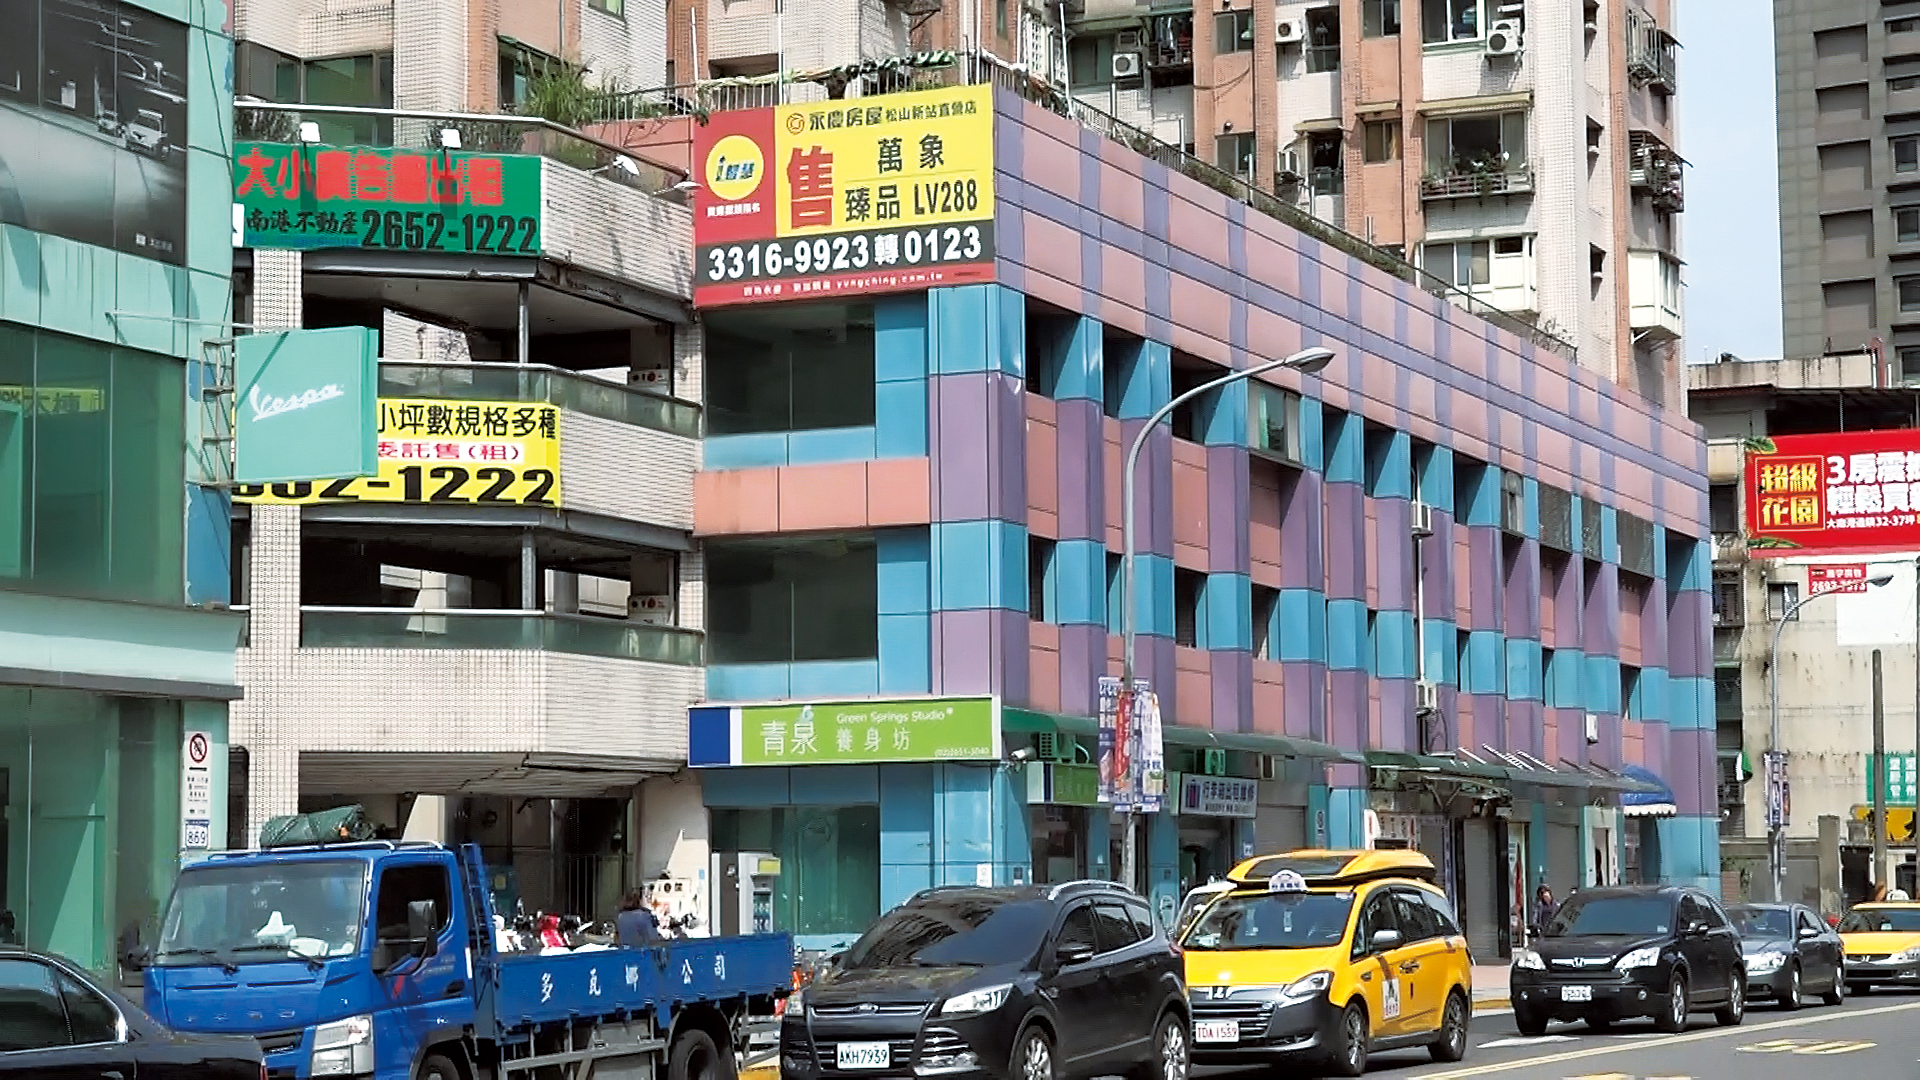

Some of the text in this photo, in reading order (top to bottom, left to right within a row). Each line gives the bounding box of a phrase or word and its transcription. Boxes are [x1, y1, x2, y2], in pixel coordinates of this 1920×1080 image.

[877, 133, 944, 175] 萬象
[785, 145, 834, 229] 售
[845, 178, 978, 222] 臻品 LV288
[249, 208, 538, 254] 南港不動產 2652-1222
[249, 383, 344, 422] Vespa
[1761, 463, 1817, 493] 超級
[1761, 494, 1819, 526] 花園
[760, 720, 819, 757] 青泉
[836, 725, 911, 753] 養身坊
